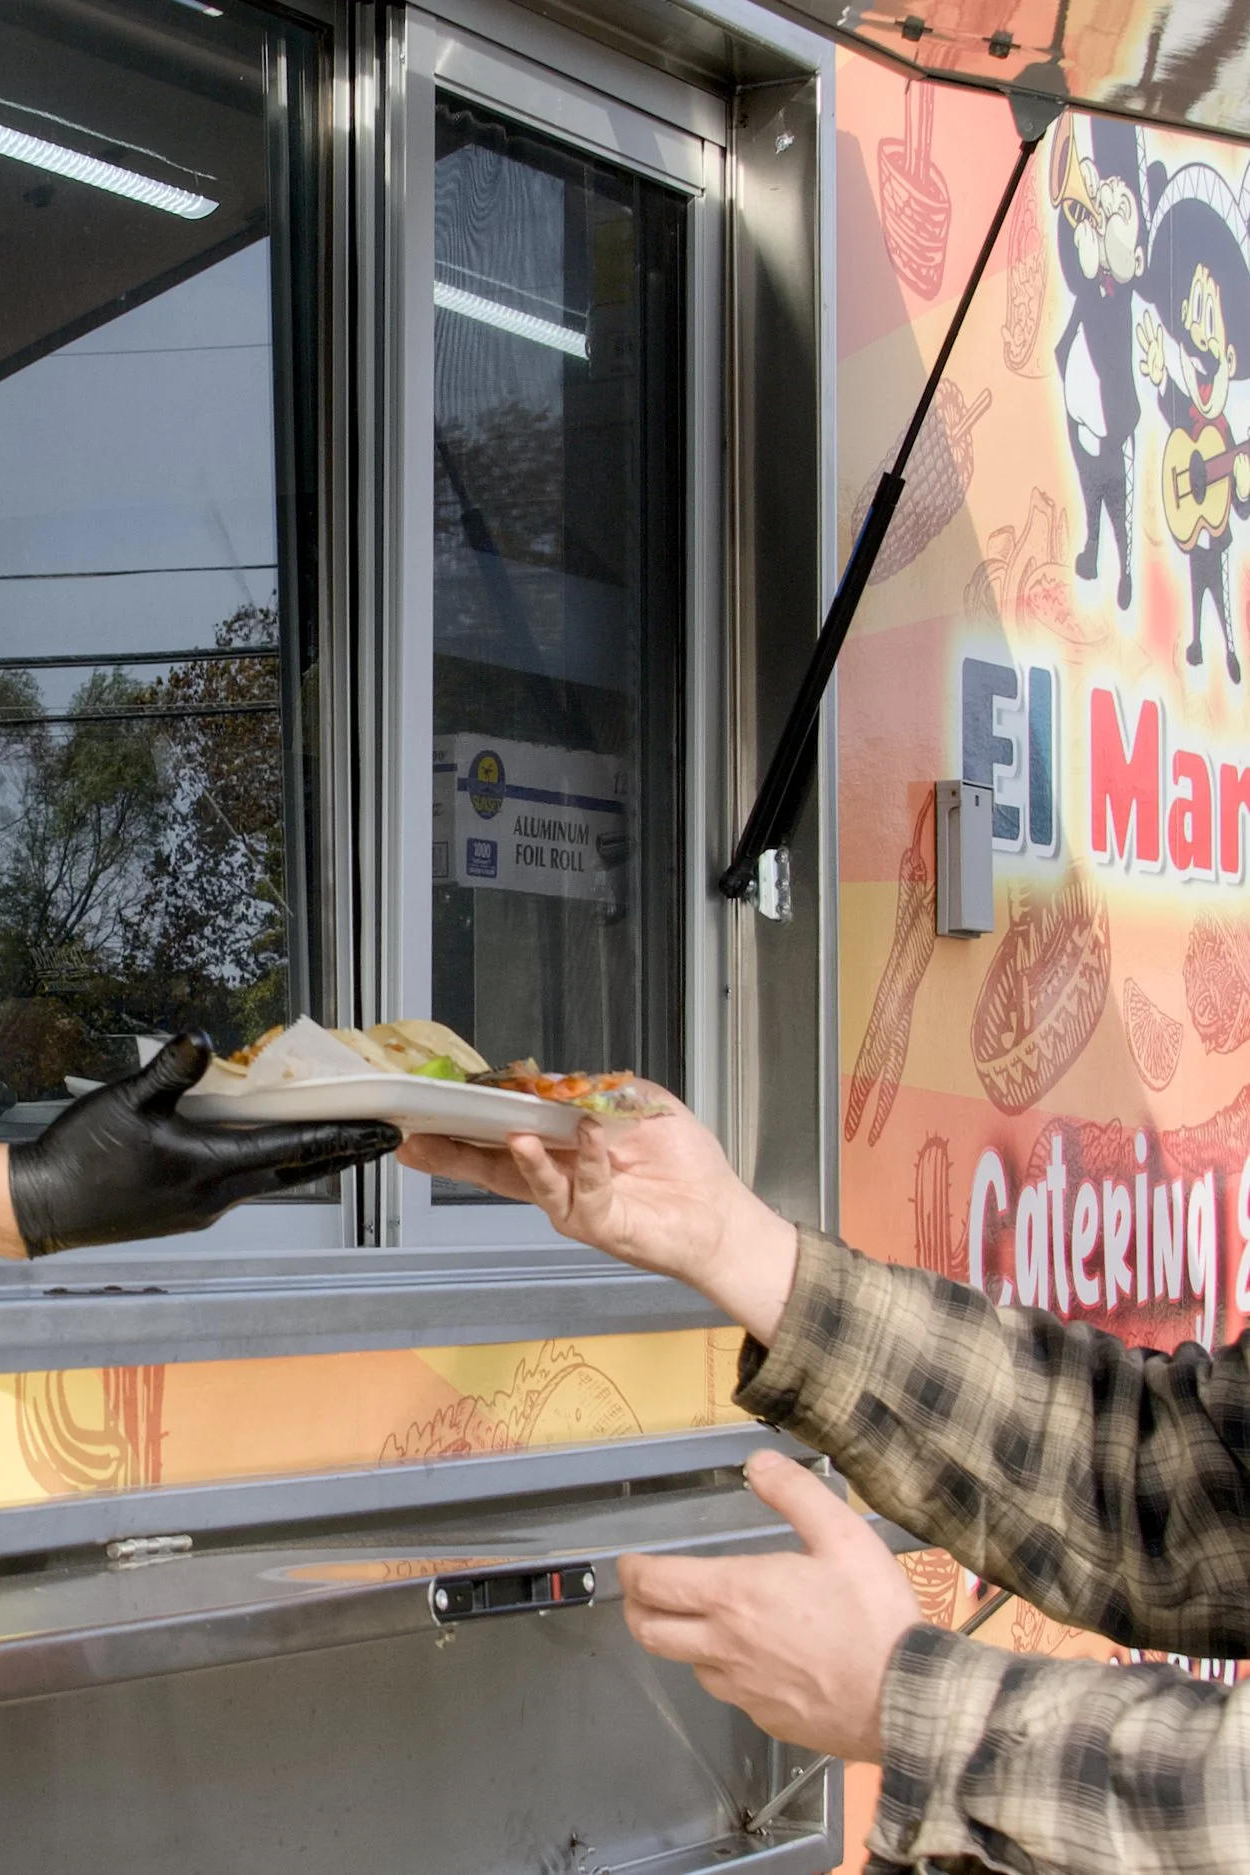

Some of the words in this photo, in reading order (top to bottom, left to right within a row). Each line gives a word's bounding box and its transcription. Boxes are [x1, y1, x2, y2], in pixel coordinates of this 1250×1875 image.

[961, 656, 1053, 847] El
[513, 815, 590, 845] ALUMINUM
[515, 843, 547, 868] FOIL
[550, 847, 586, 873] ROLL
